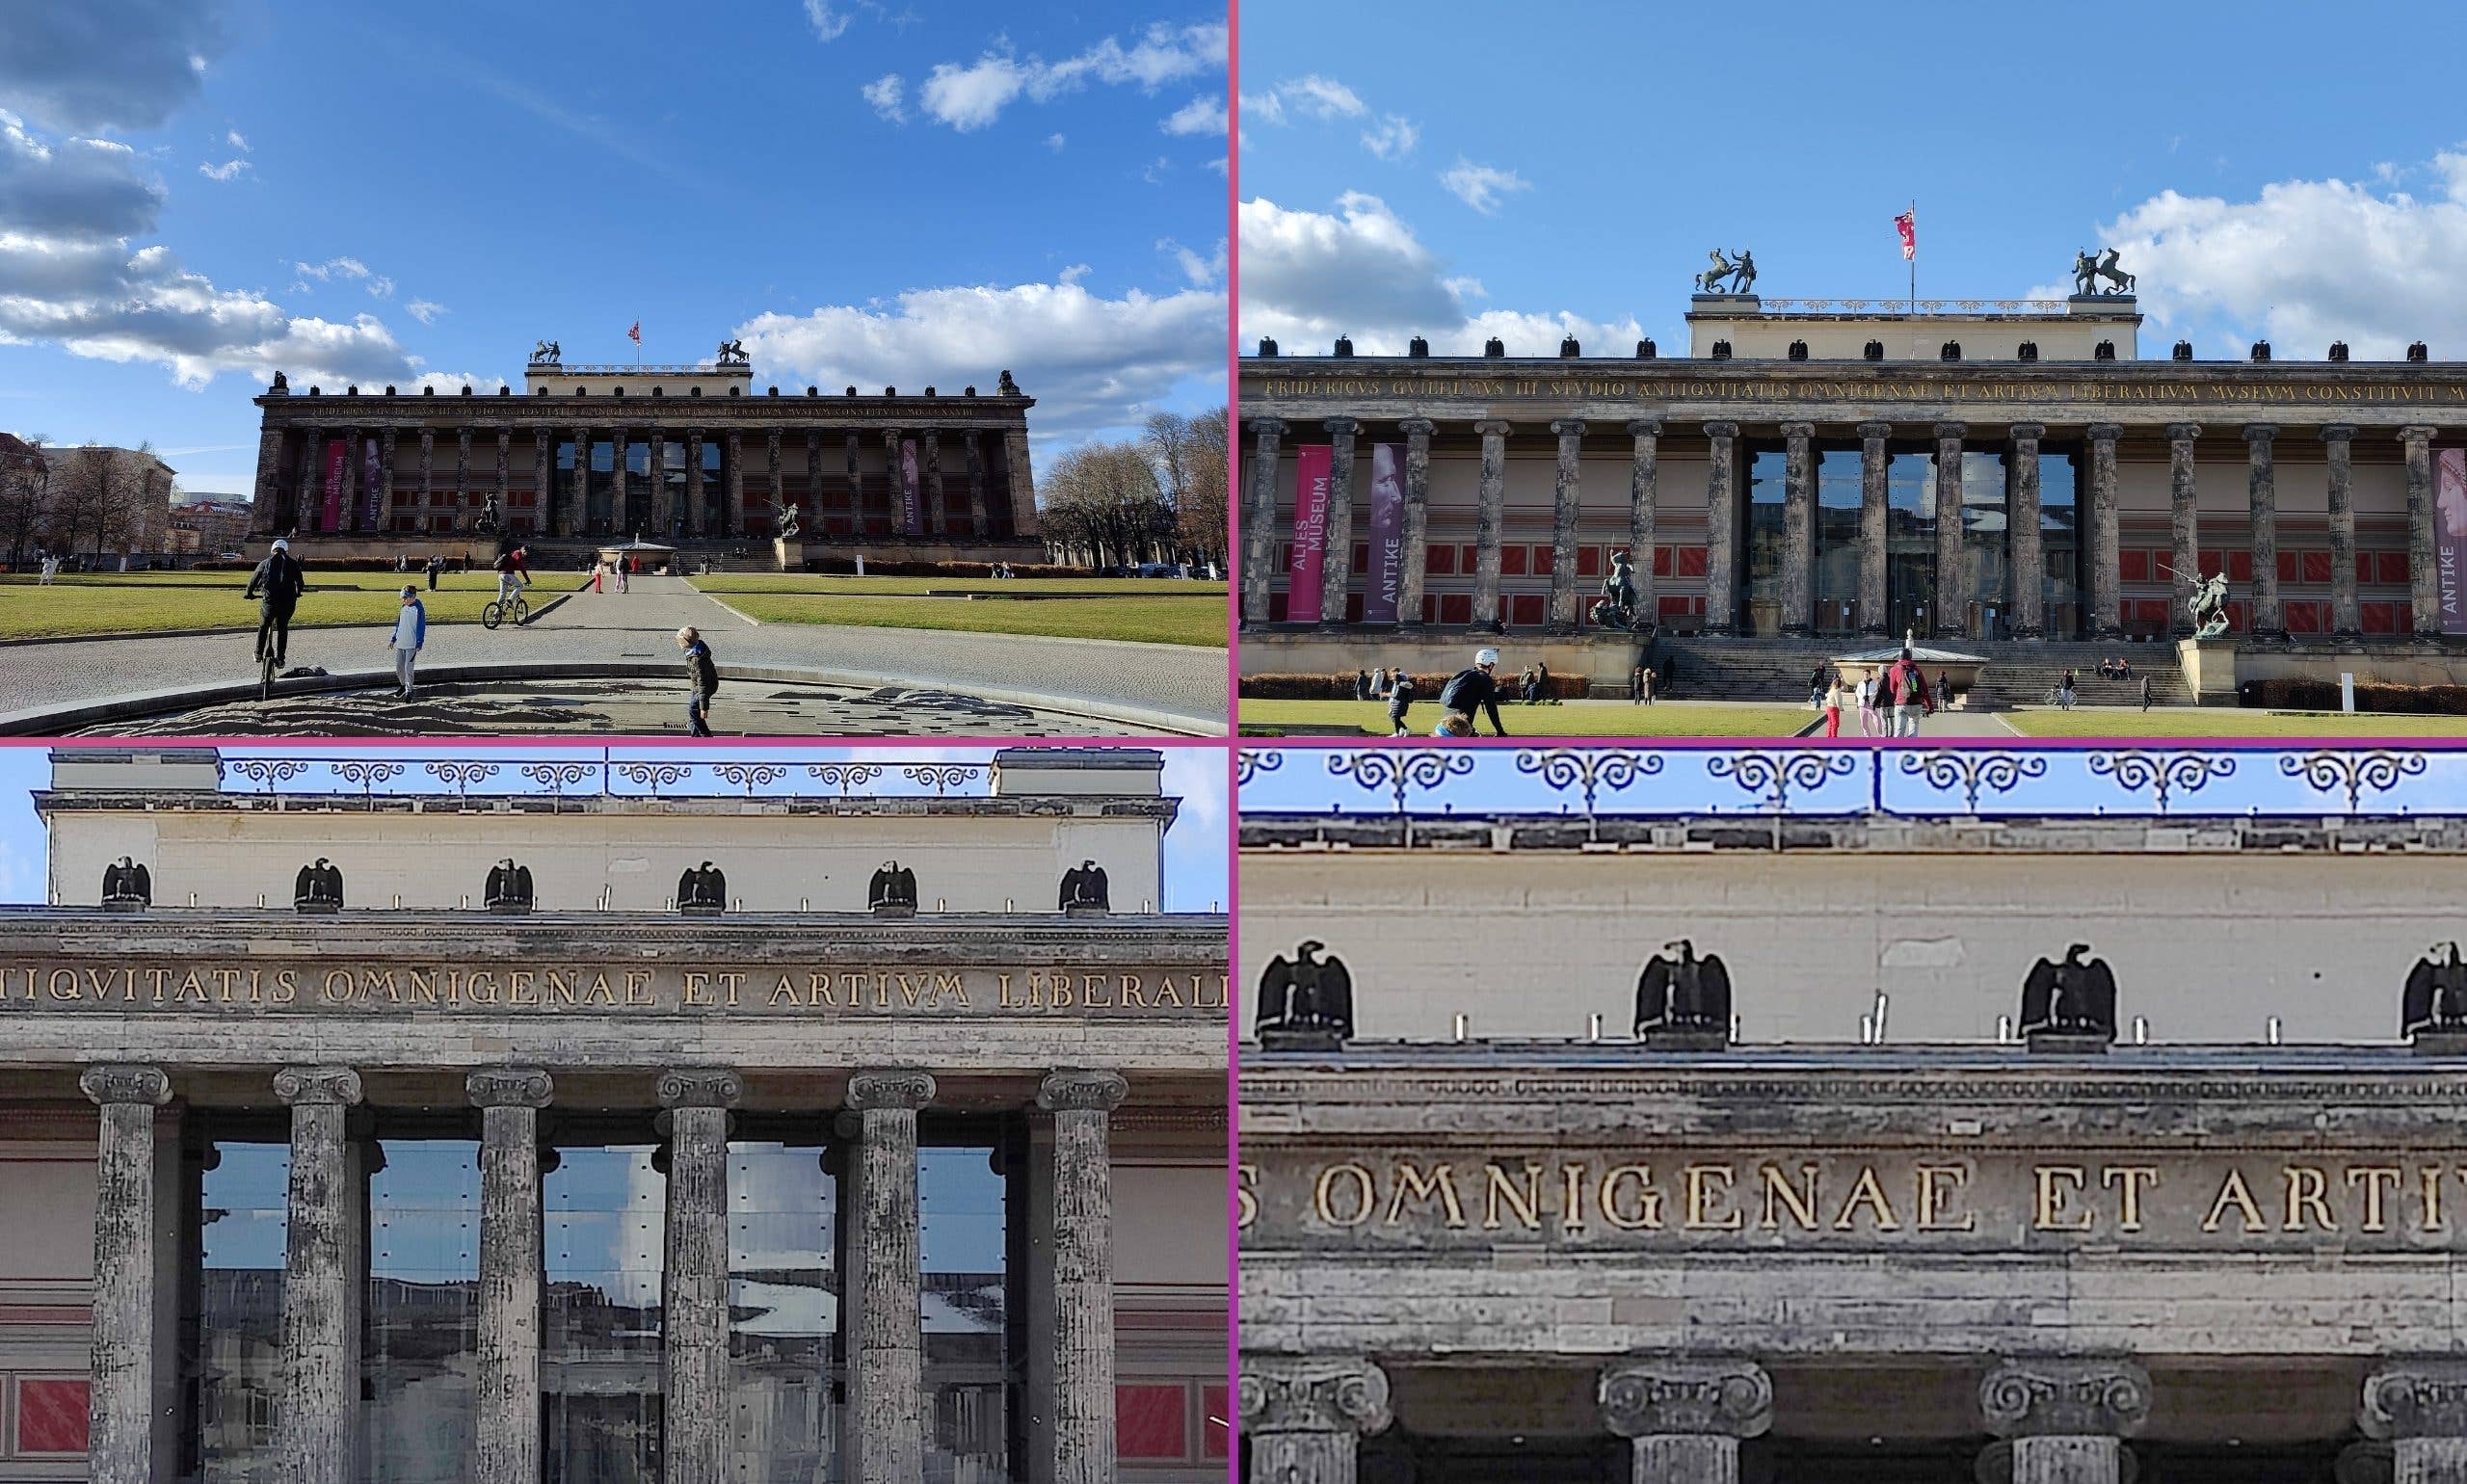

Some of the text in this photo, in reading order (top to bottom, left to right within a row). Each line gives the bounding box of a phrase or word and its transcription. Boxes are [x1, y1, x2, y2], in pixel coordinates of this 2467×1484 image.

[1264, 380, 1380, 395] FRIDERICVS
[1515, 382, 1539, 396] III
[1550, 382, 1626, 397] STVDIO
[1637, 383, 1791, 398] ANTIQVITATIS
[1800, 383, 1932, 399] OMNIGENAE
[1943, 384, 1970, 399] ET
[1977, 384, 2061, 399] ARTIVM
[2070, 384, 2199, 400] LIBERALIVM
[2209, 385, 2296, 400] MVSEVM
[2306, 385, 2438, 401] CONSTITVIT
[370, 487, 380, 521] ANTIKE
[904, 489, 915, 525] ANTIKE
[1308, 477, 1328, 552] MUSEUM
[1292, 519, 1309, 570] ALTES
[1382, 538, 1400, 603] ANTIKE
[2440, 545, 2457, 614] ANTIKE
[323, 968, 656, 1007] OMNIGENAE
[681, 971, 749, 1008] ET
[767, 971, 972, 1009] ARTIVM
[997, 972, 1229, 1010] LIBERALI
[1313, 1162, 1976, 1232] OMNIGENAE
[2032, 1164, 2160, 1233] ET
[2202, 1164, 2467, 1234] ARTI
